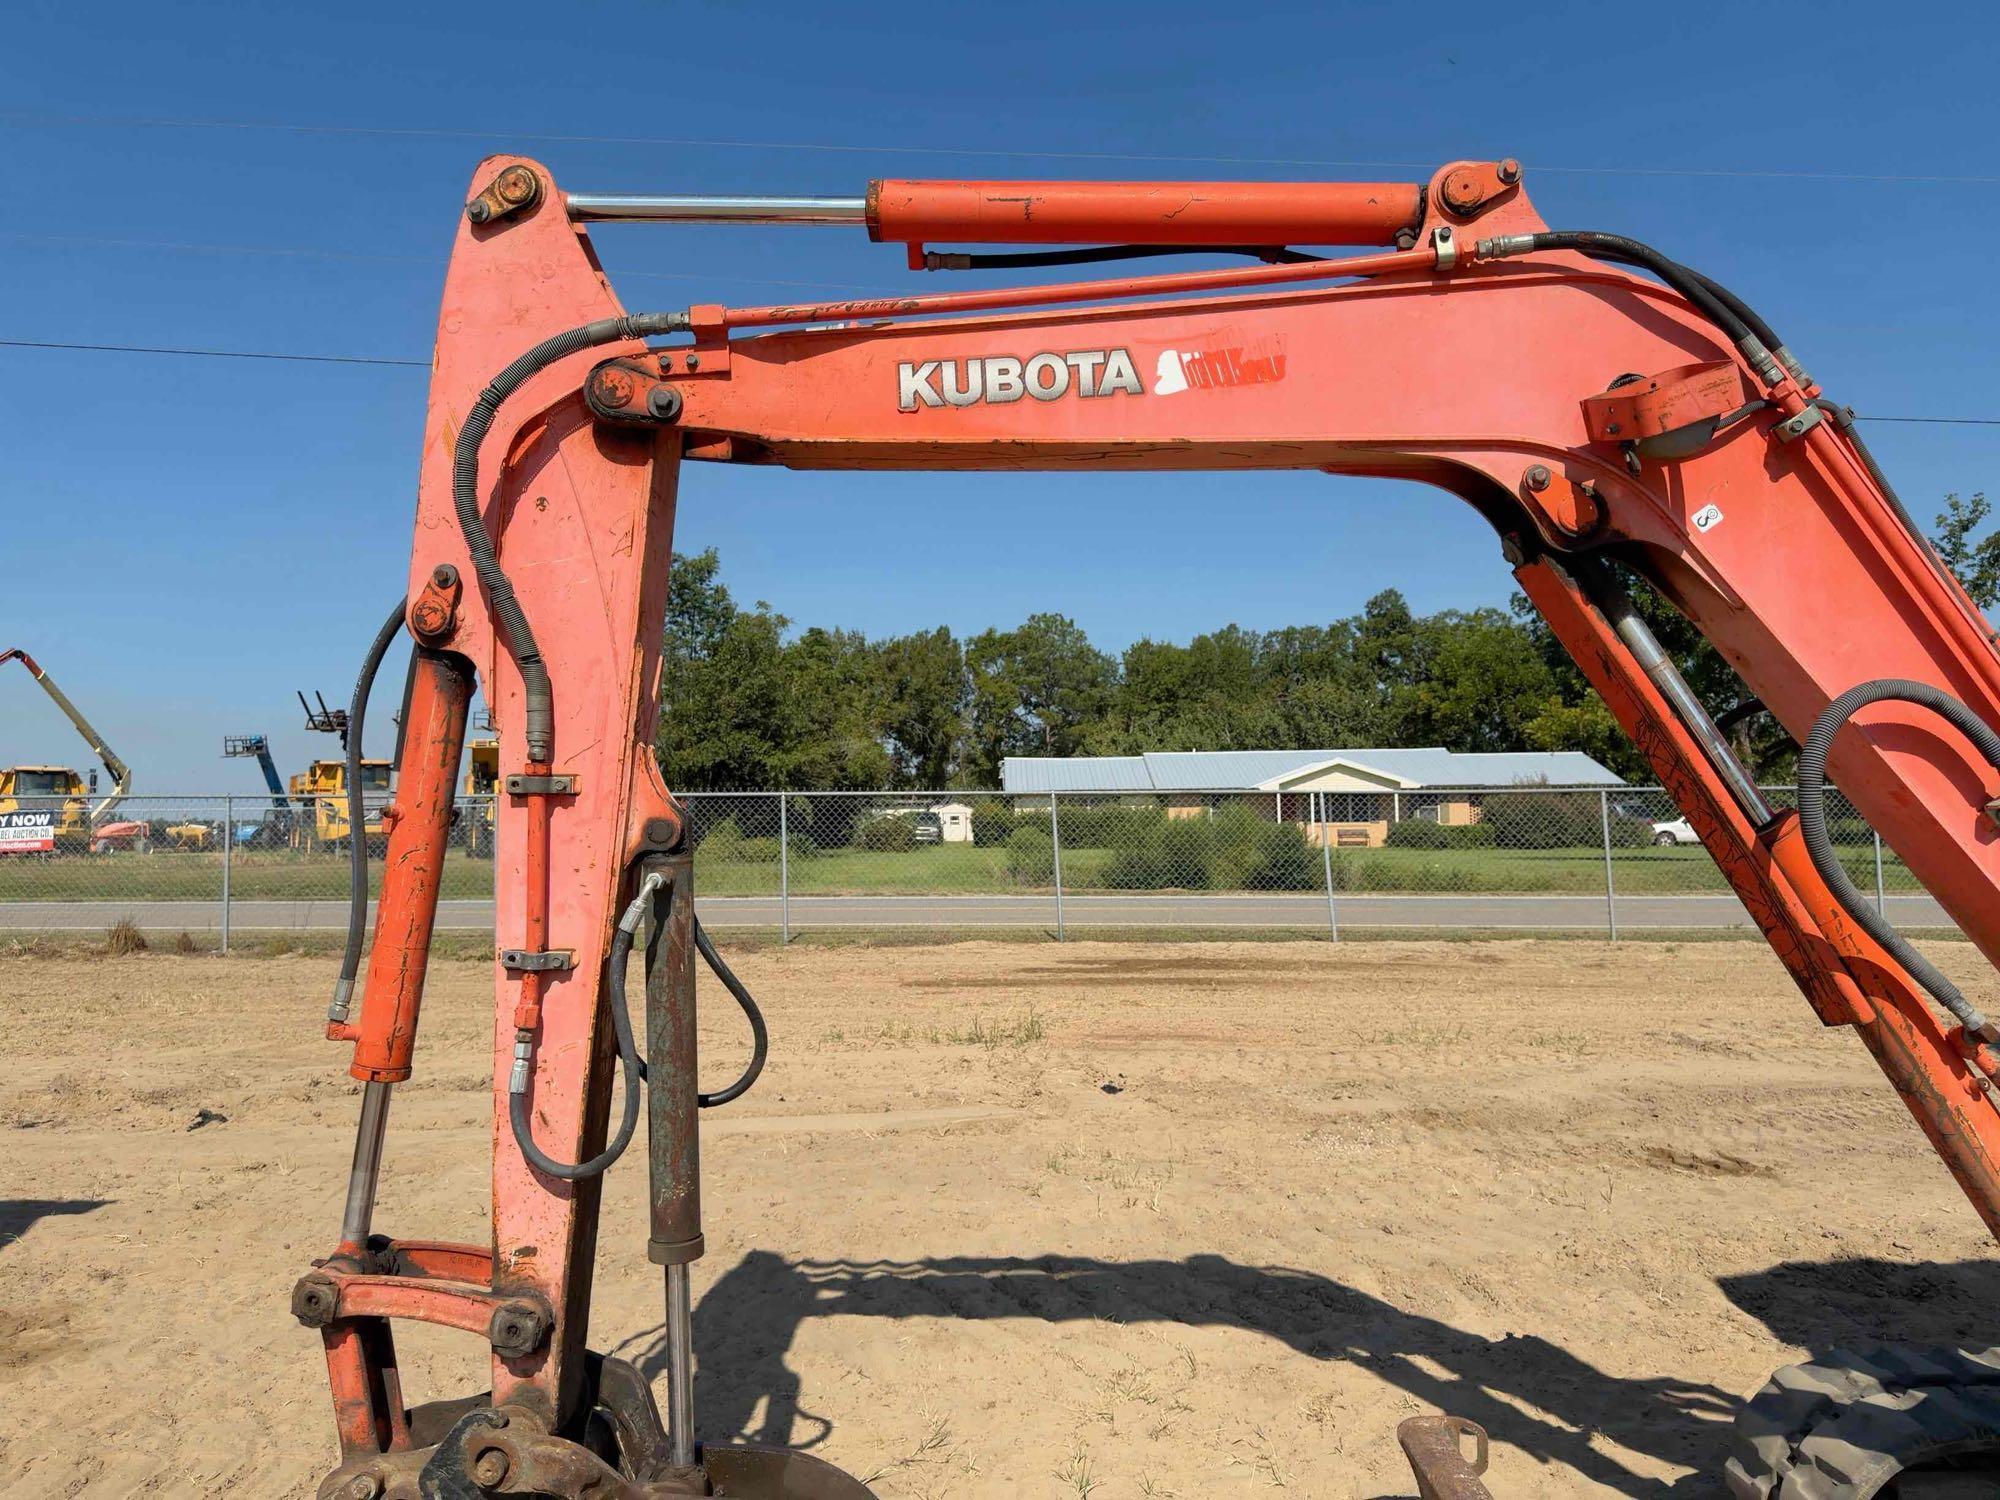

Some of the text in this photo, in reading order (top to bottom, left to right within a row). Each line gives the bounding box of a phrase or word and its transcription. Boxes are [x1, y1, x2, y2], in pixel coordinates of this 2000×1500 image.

[898, 348, 1144, 409] KUBOTA
[12, 814, 51, 827] NOW
[13, 829, 39, 839] AUCTION
[40, 828, 52, 838] CO.
